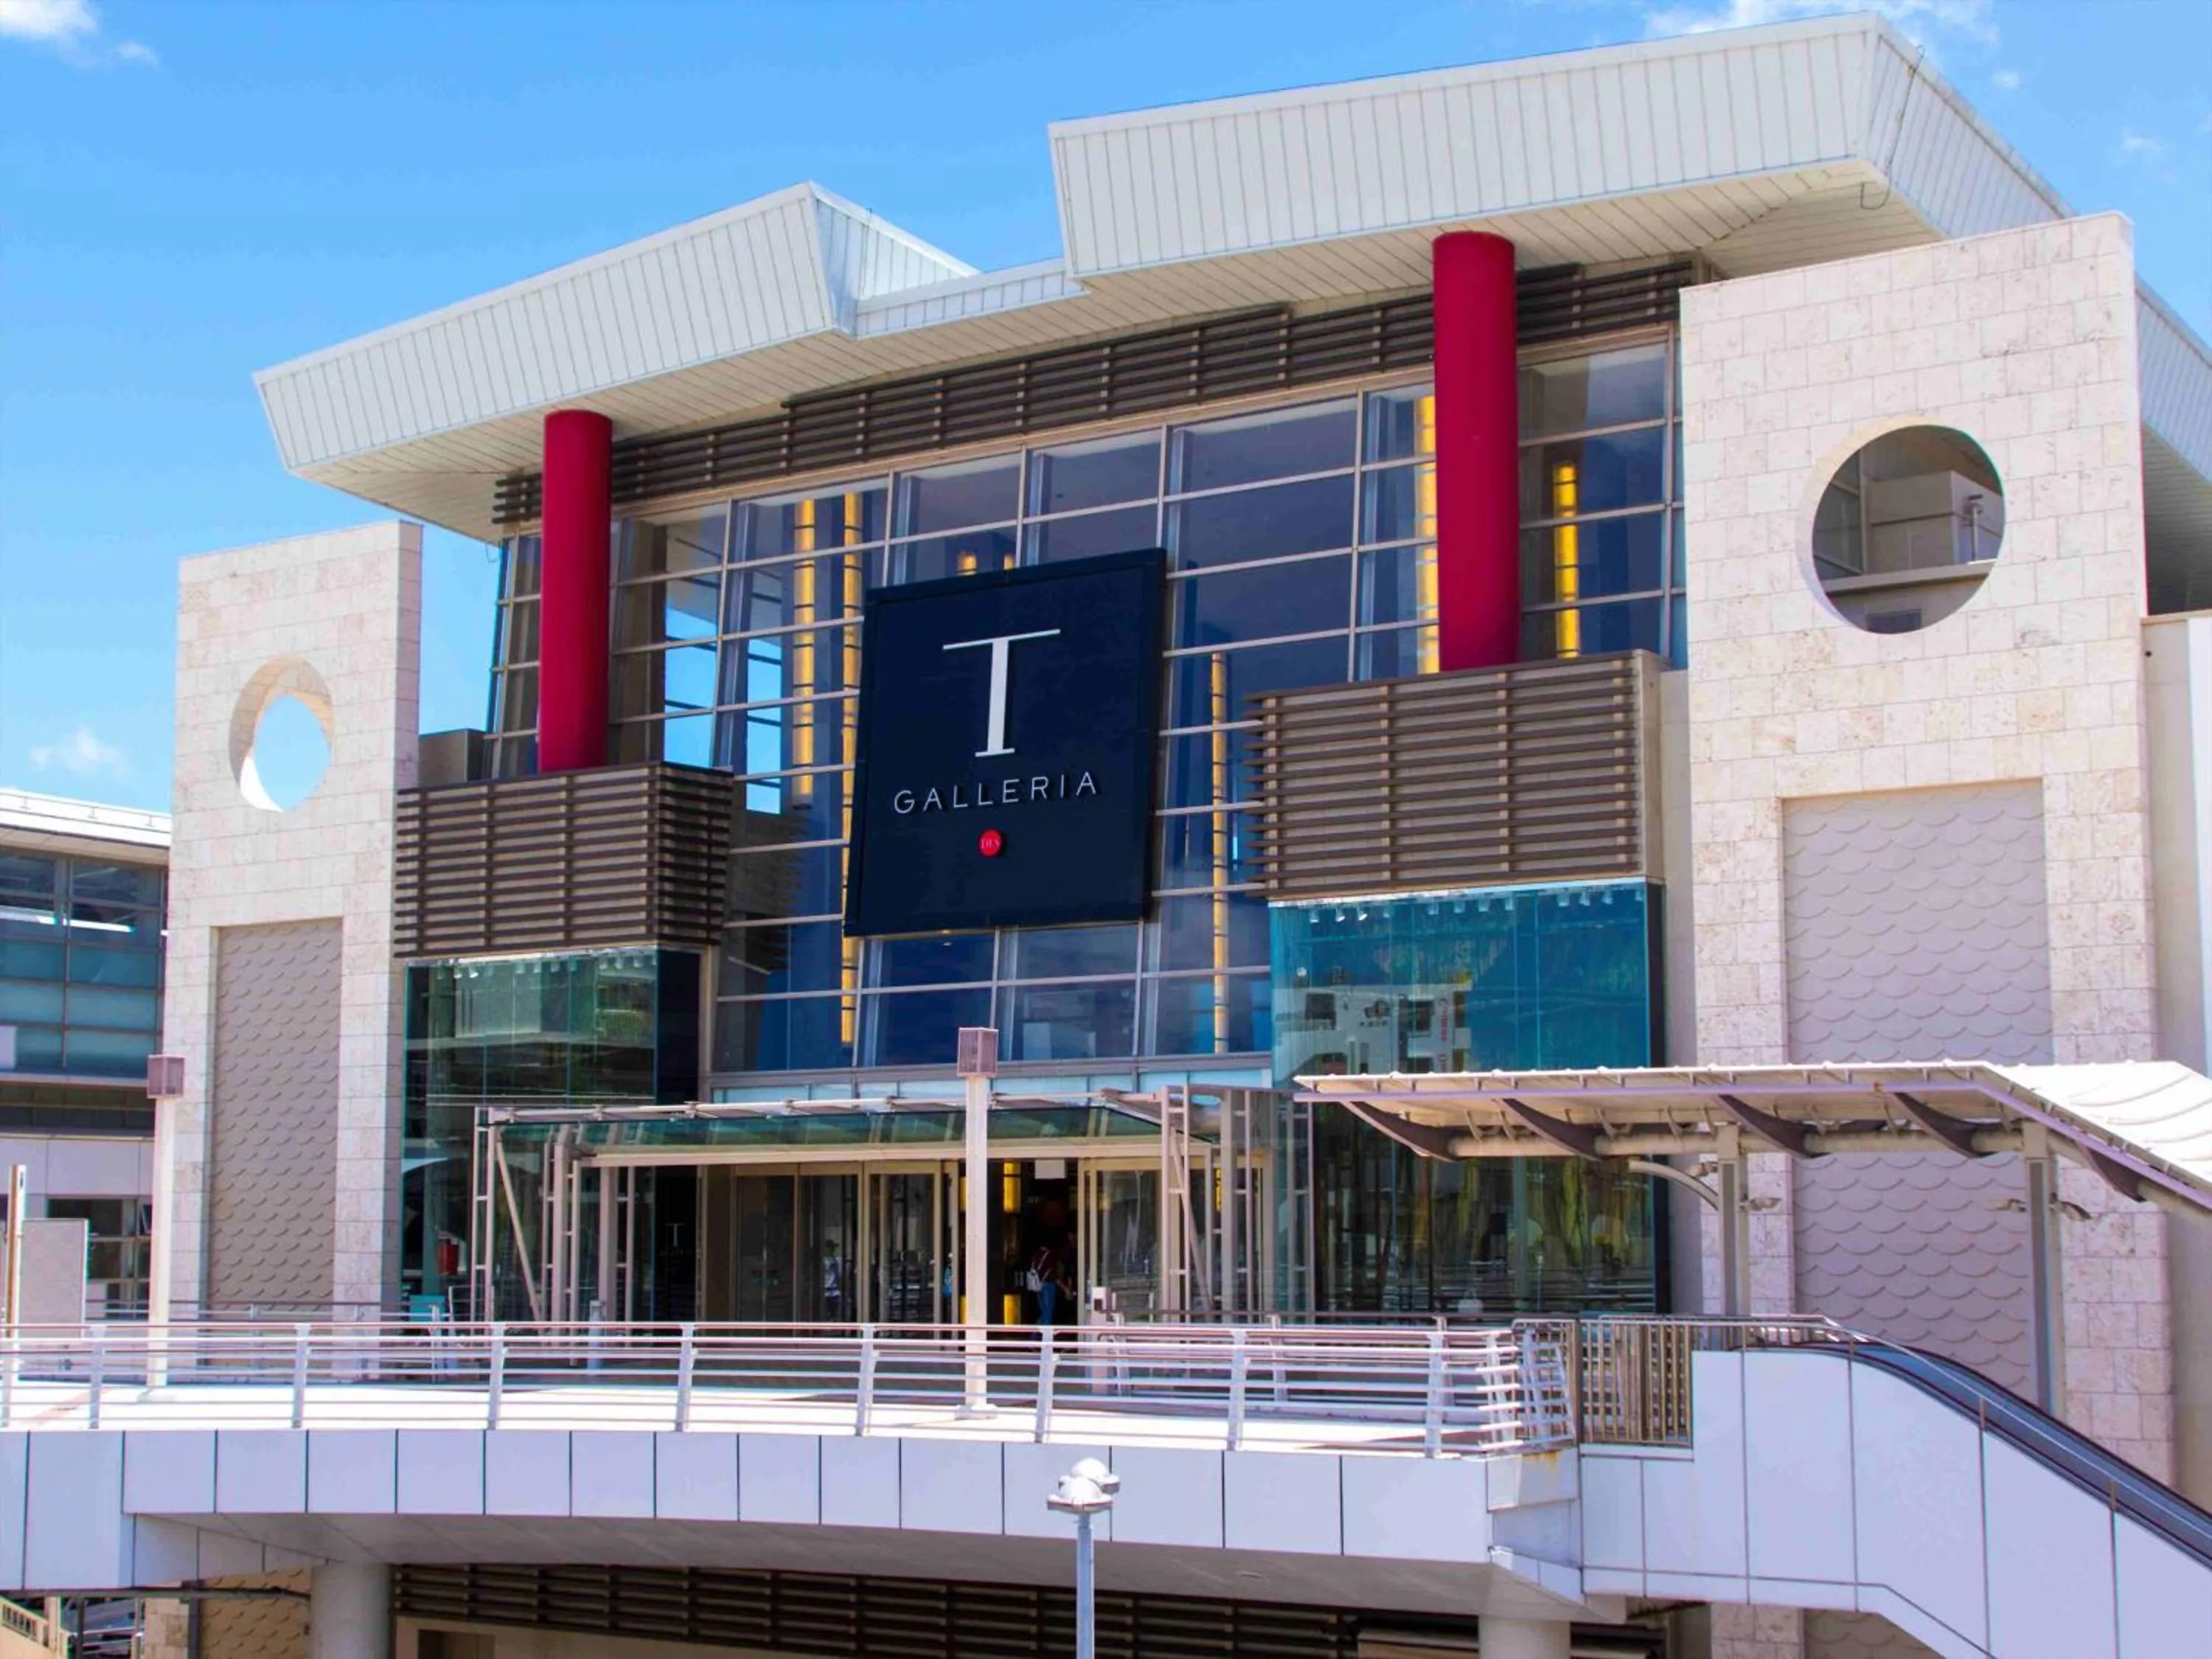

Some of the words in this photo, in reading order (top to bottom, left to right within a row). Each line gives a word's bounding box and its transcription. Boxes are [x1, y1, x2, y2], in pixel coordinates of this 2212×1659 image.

[942, 629, 1061, 758] T
[893, 771, 1097, 814] GALLERIA
[663, 1222, 686, 1248] T
